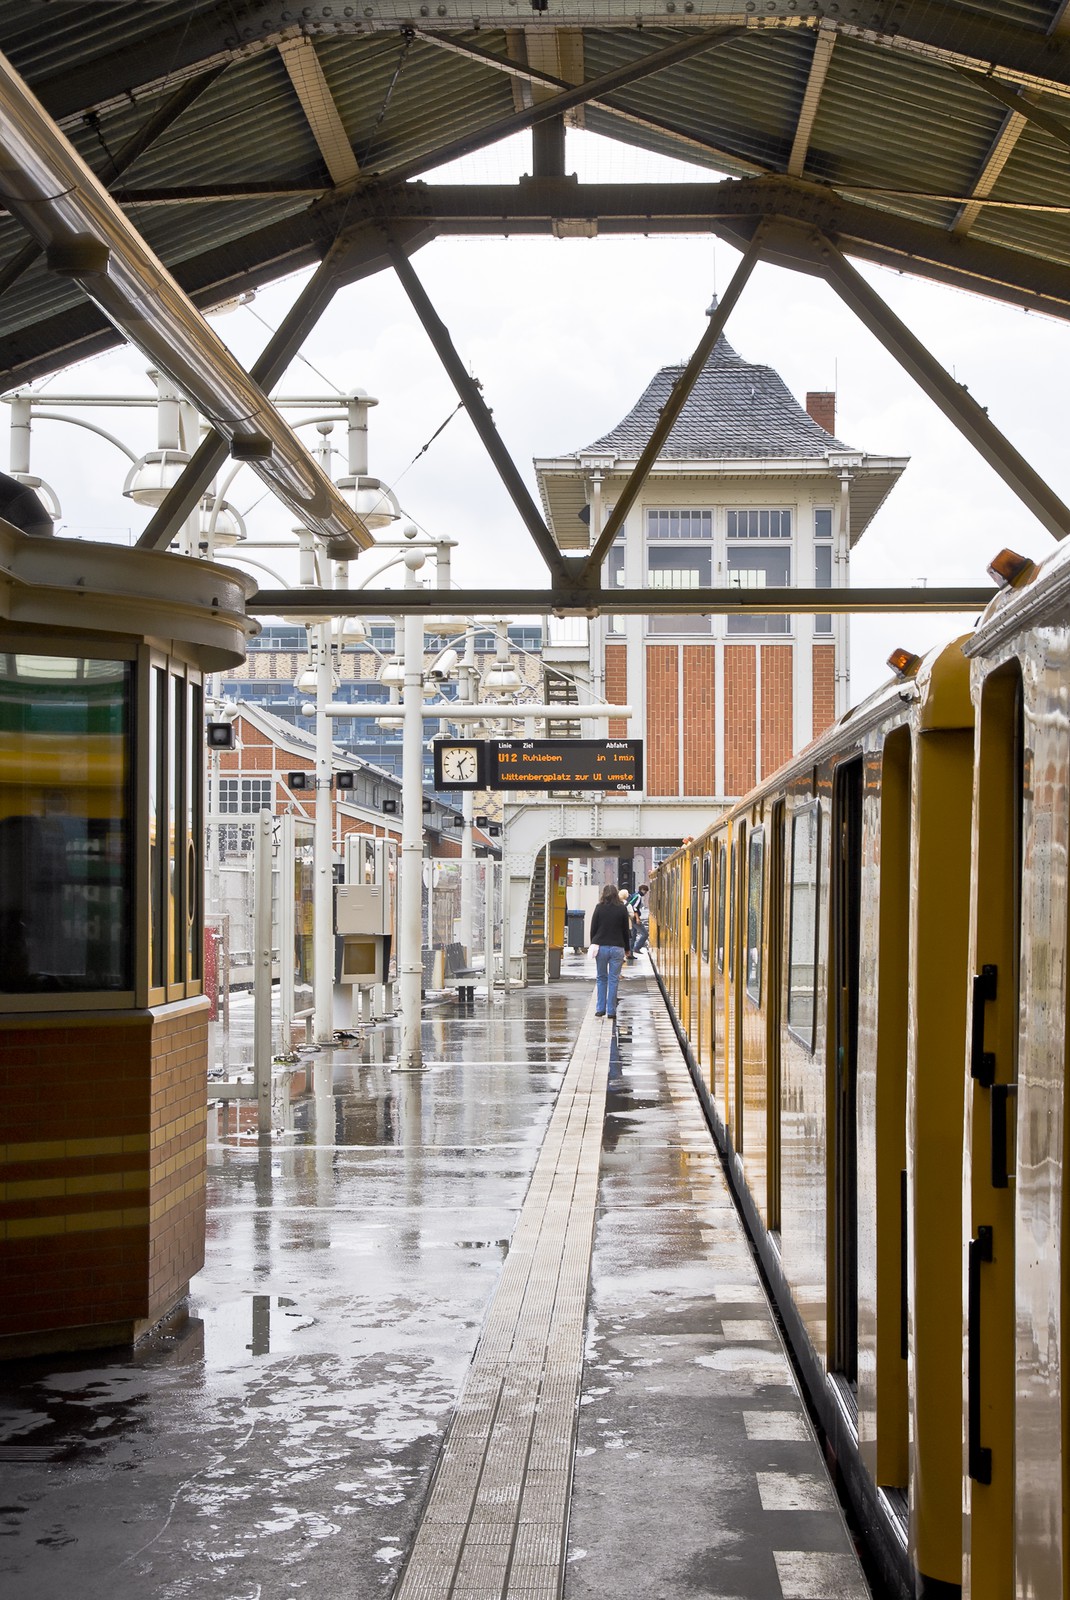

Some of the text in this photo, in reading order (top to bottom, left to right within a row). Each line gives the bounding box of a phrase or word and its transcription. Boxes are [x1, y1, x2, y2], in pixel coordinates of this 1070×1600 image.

[498, 753, 518, 763] U12
[522, 754, 563, 762] Ruhleben
[596, 754, 606, 762] in
[501, 773, 571, 783] Wittenbergplatz
[593, 773, 602, 781] U1
[607, 773, 634, 781] umste
